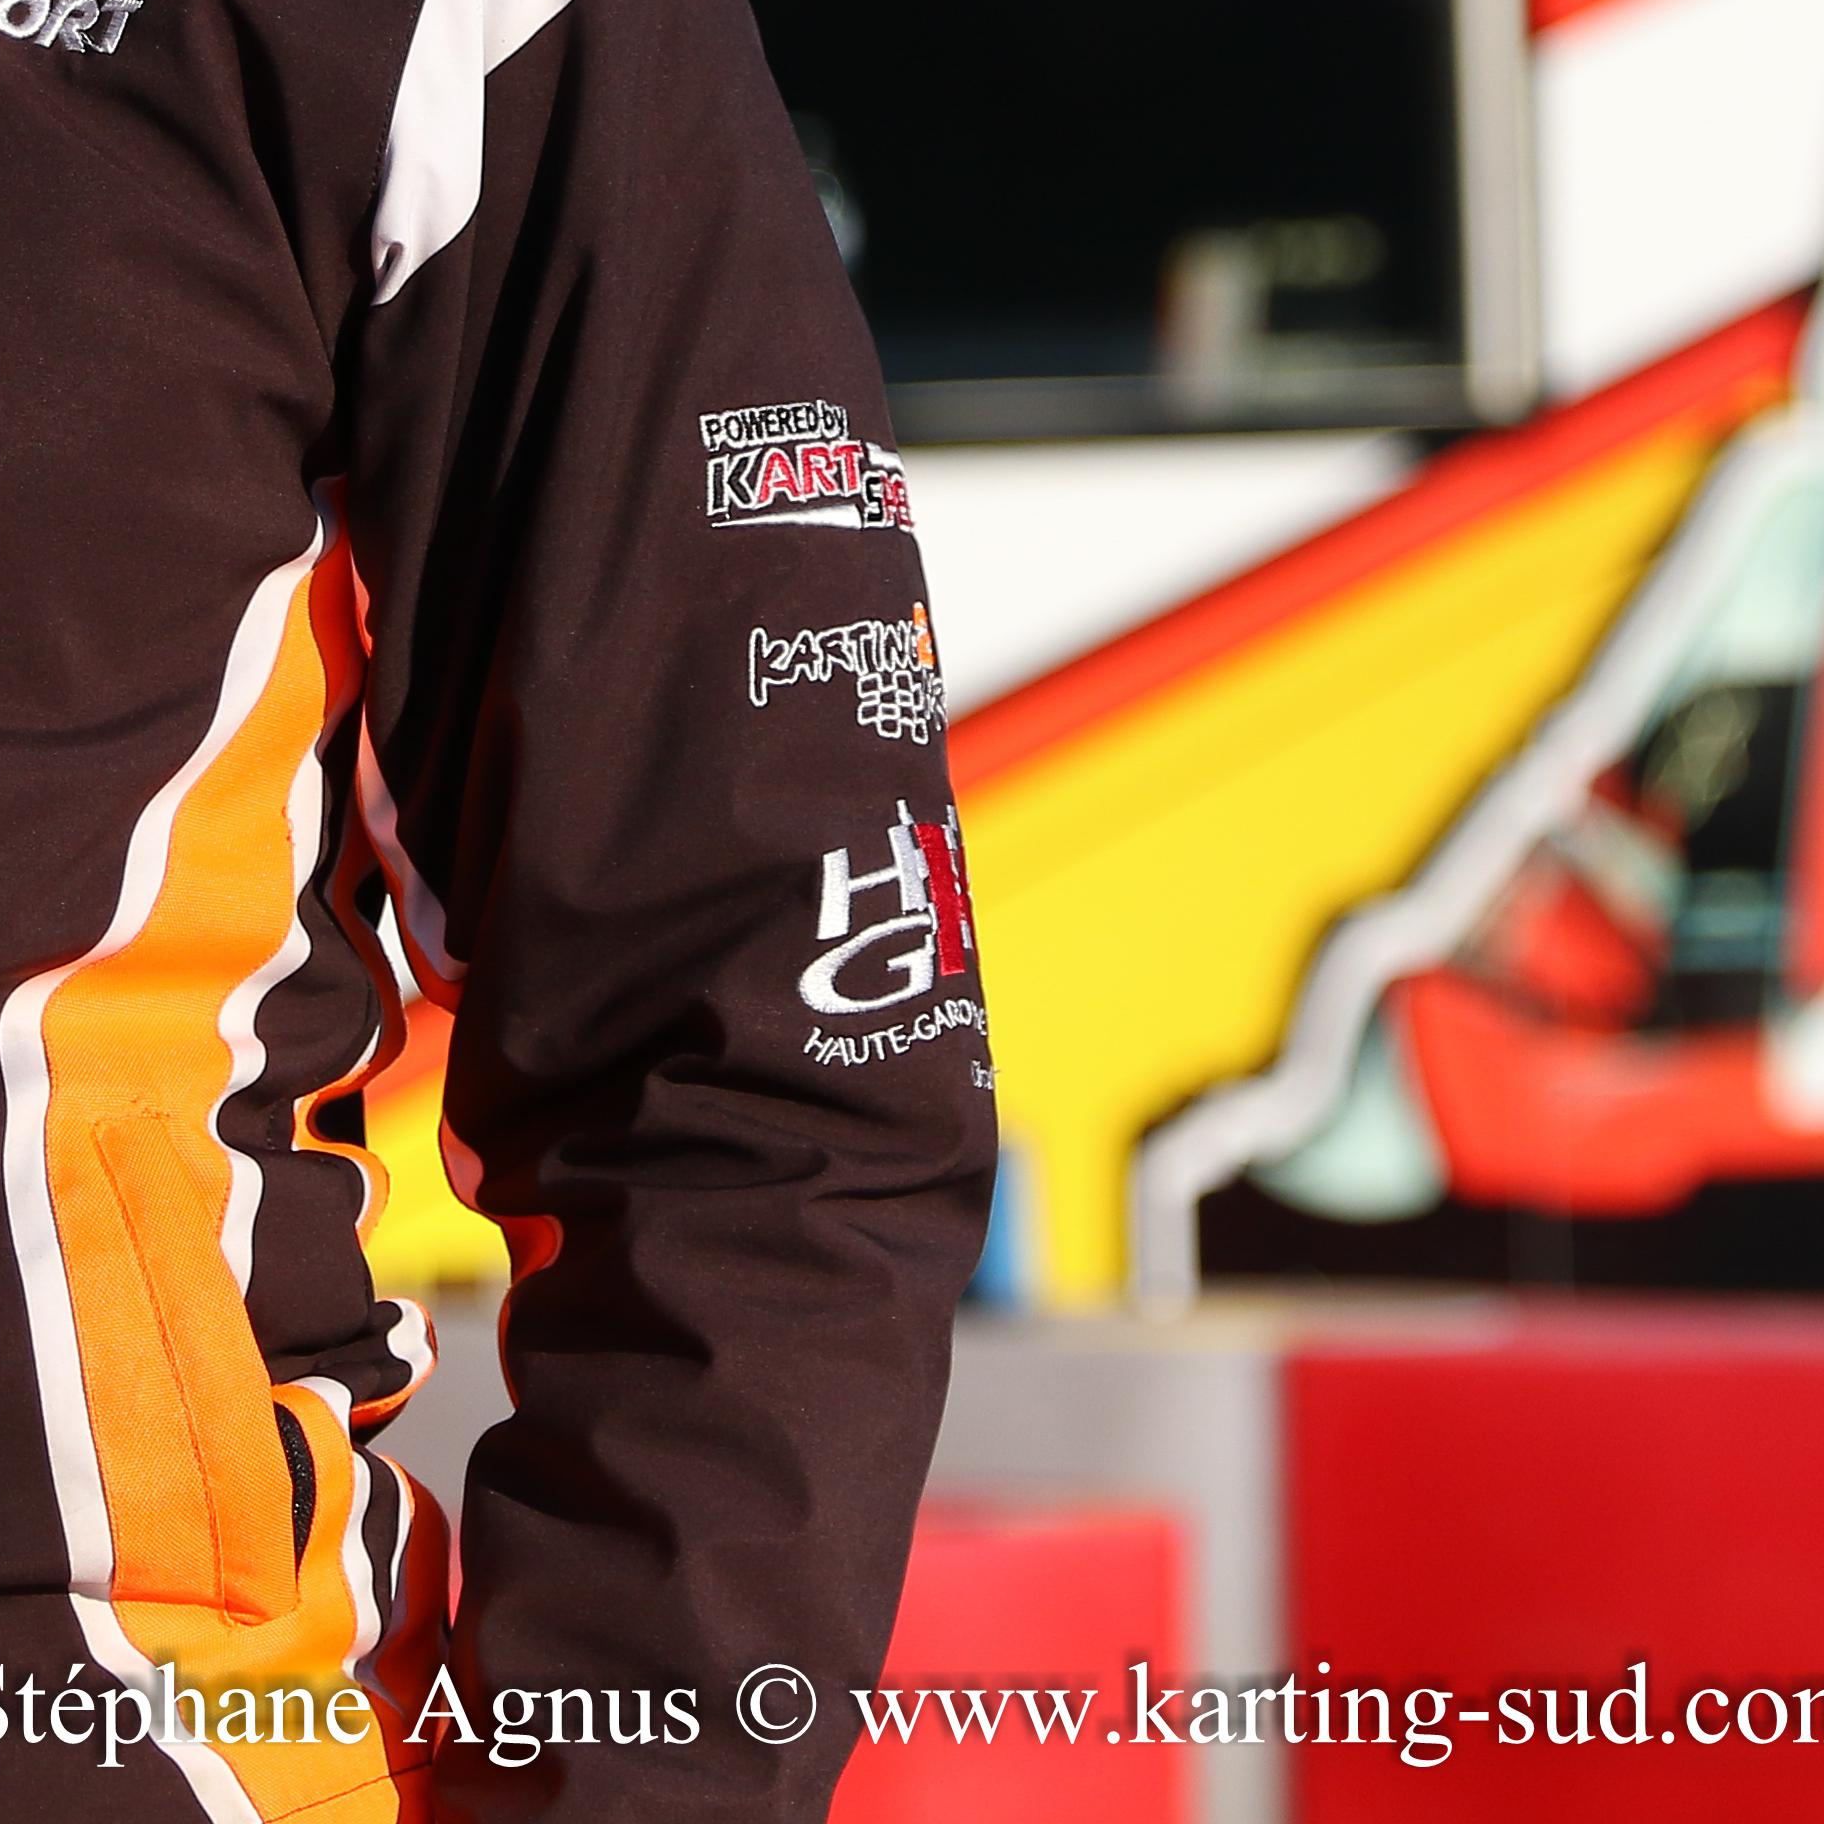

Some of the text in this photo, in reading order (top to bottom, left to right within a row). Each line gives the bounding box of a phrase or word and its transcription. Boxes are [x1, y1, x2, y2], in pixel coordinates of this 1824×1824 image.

[700, 399, 849, 451] POWERED by
[707, 440, 864, 516] KART
